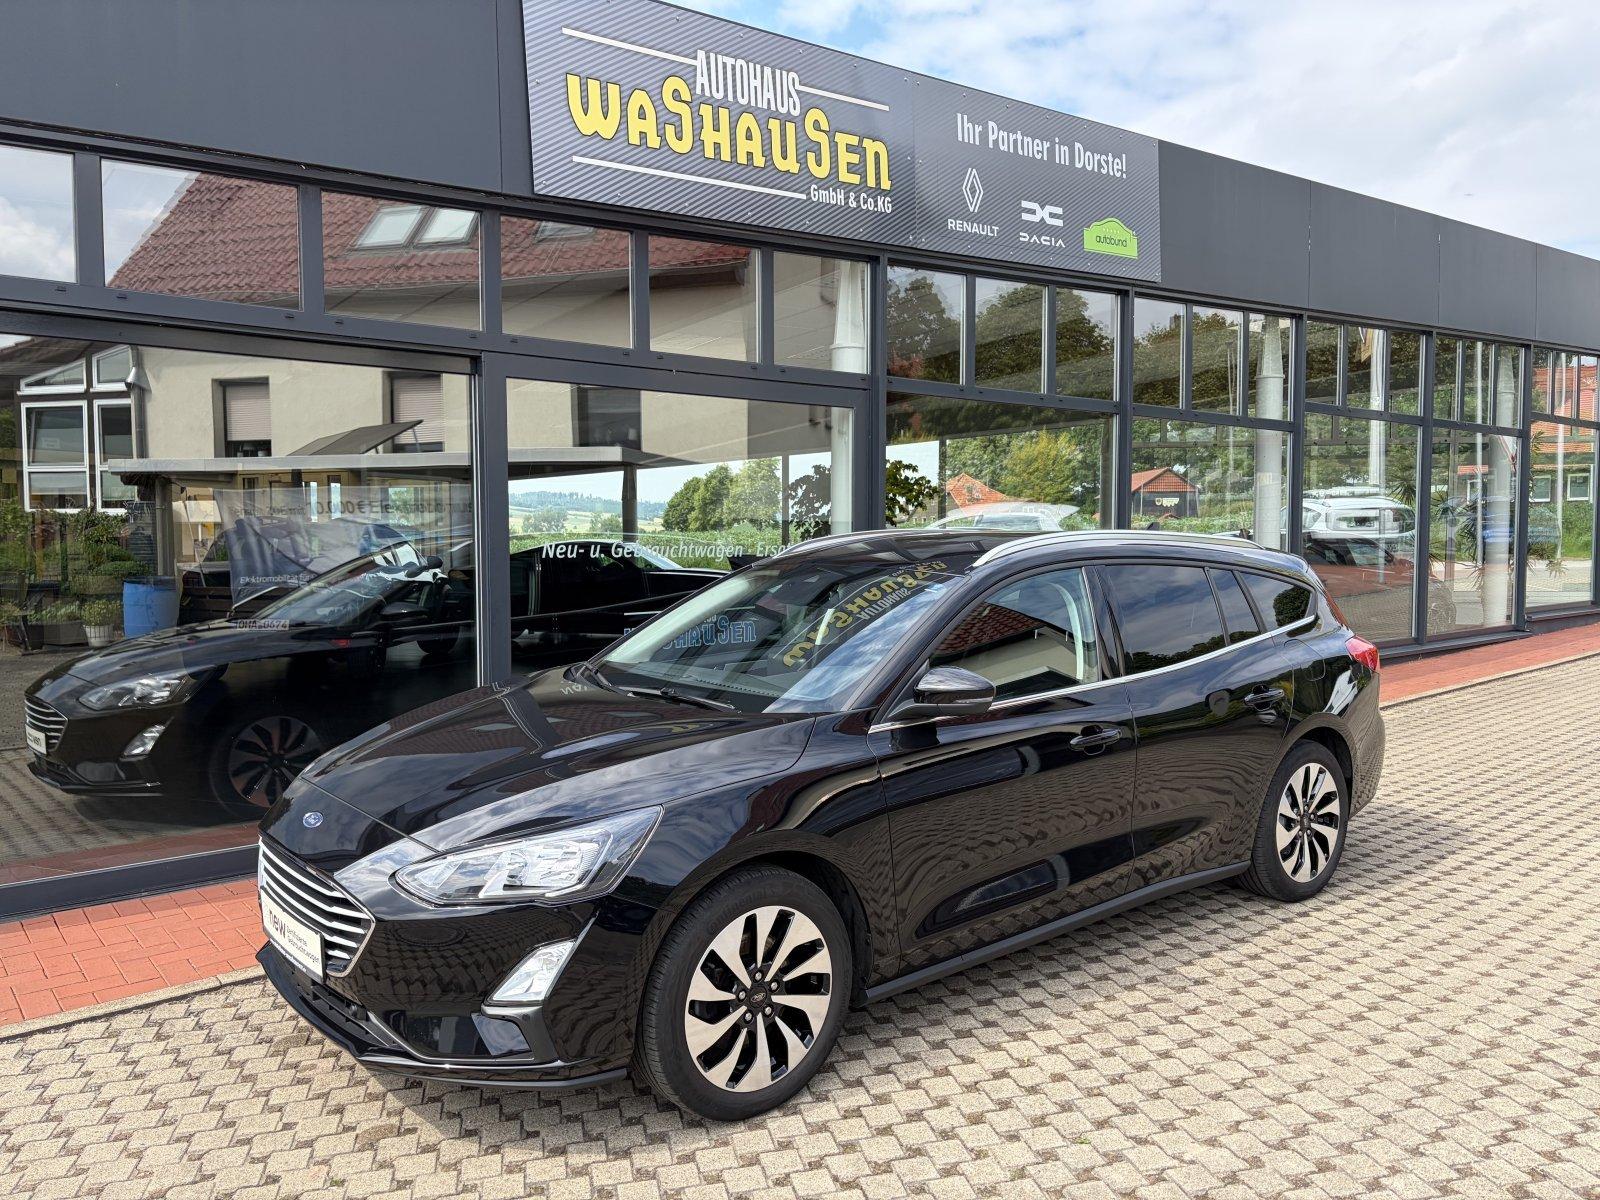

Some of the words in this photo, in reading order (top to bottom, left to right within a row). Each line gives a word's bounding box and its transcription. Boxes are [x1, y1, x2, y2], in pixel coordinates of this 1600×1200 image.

[695, 49, 801, 117] AUTOHAUS
[956, 112, 983, 146] Ihr
[987, 120, 1050, 161] Partner
[1054, 136, 1070, 167] in
[1074, 141, 1128, 179] Dorste!
[810, 184, 845, 206] GmbH
[848, 192, 857, 208] &
[860, 192, 892, 214] Co.KG
[947, 218, 1000, 238] RENAULT
[1019, 231, 1067, 249] DACIA
[1094, 234, 1128, 249] autobund
[541, 541, 585, 559] Neu-
[589, 546, 605, 559] u.
[610, 541, 744, 562] Gebrauchtwagen
